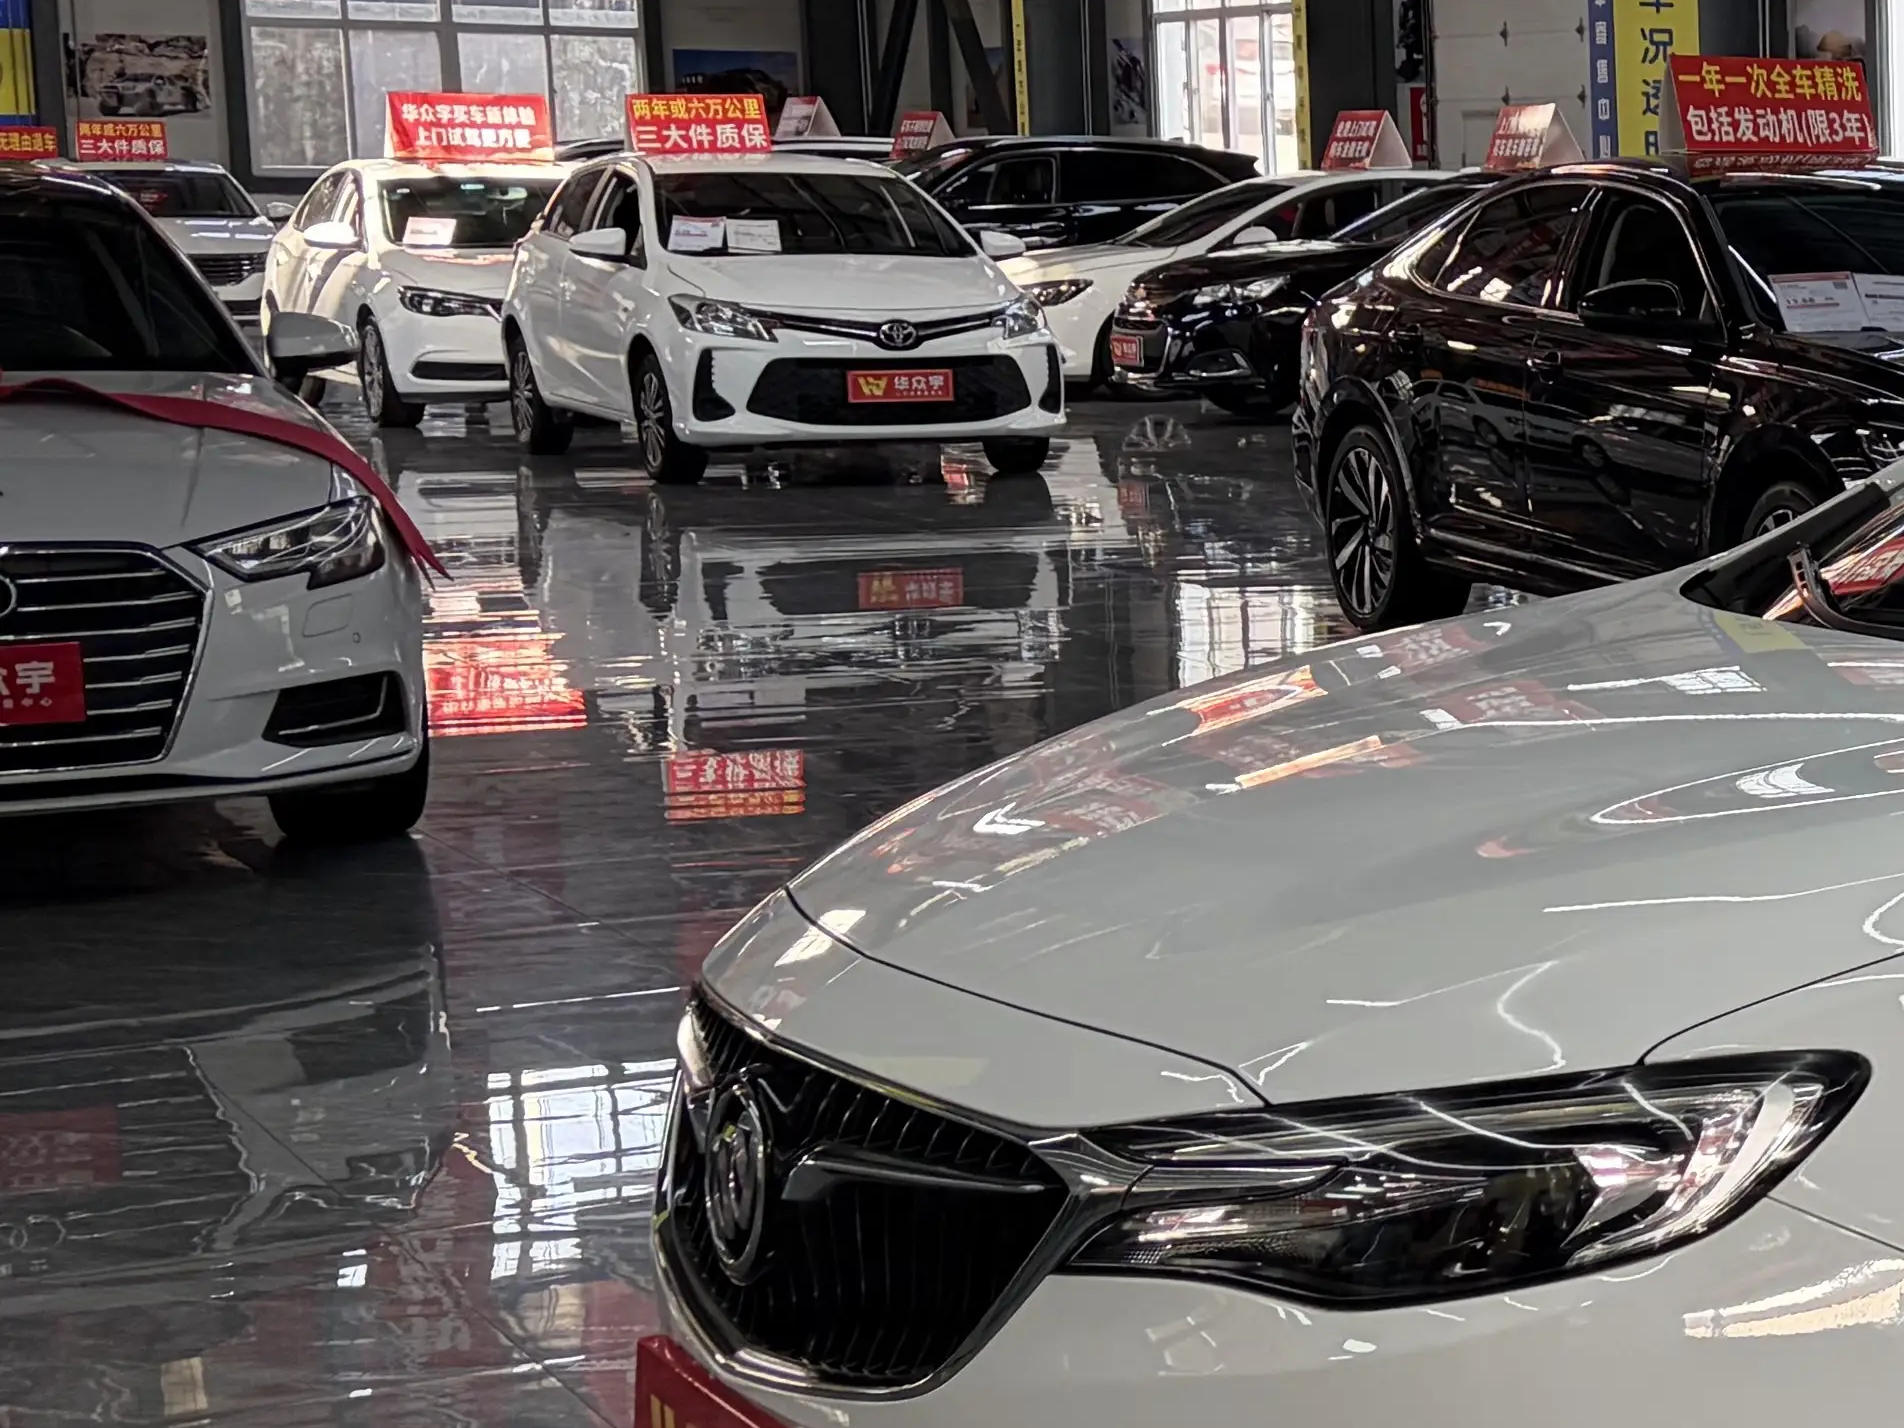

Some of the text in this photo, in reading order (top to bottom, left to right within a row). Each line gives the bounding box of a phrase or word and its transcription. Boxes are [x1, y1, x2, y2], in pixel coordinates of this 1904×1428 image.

[1677, 60, 1863, 103] 一年一次全车精洗
[631, 97, 763, 121] 两年或六万公里
[635, 122, 769, 150] 三大件质保
[1686, 104, 1874, 149] 包括发动机(限3年)
[79, 138, 166, 155] 三大件质保
[893, 375, 945, 391] 华众宇
